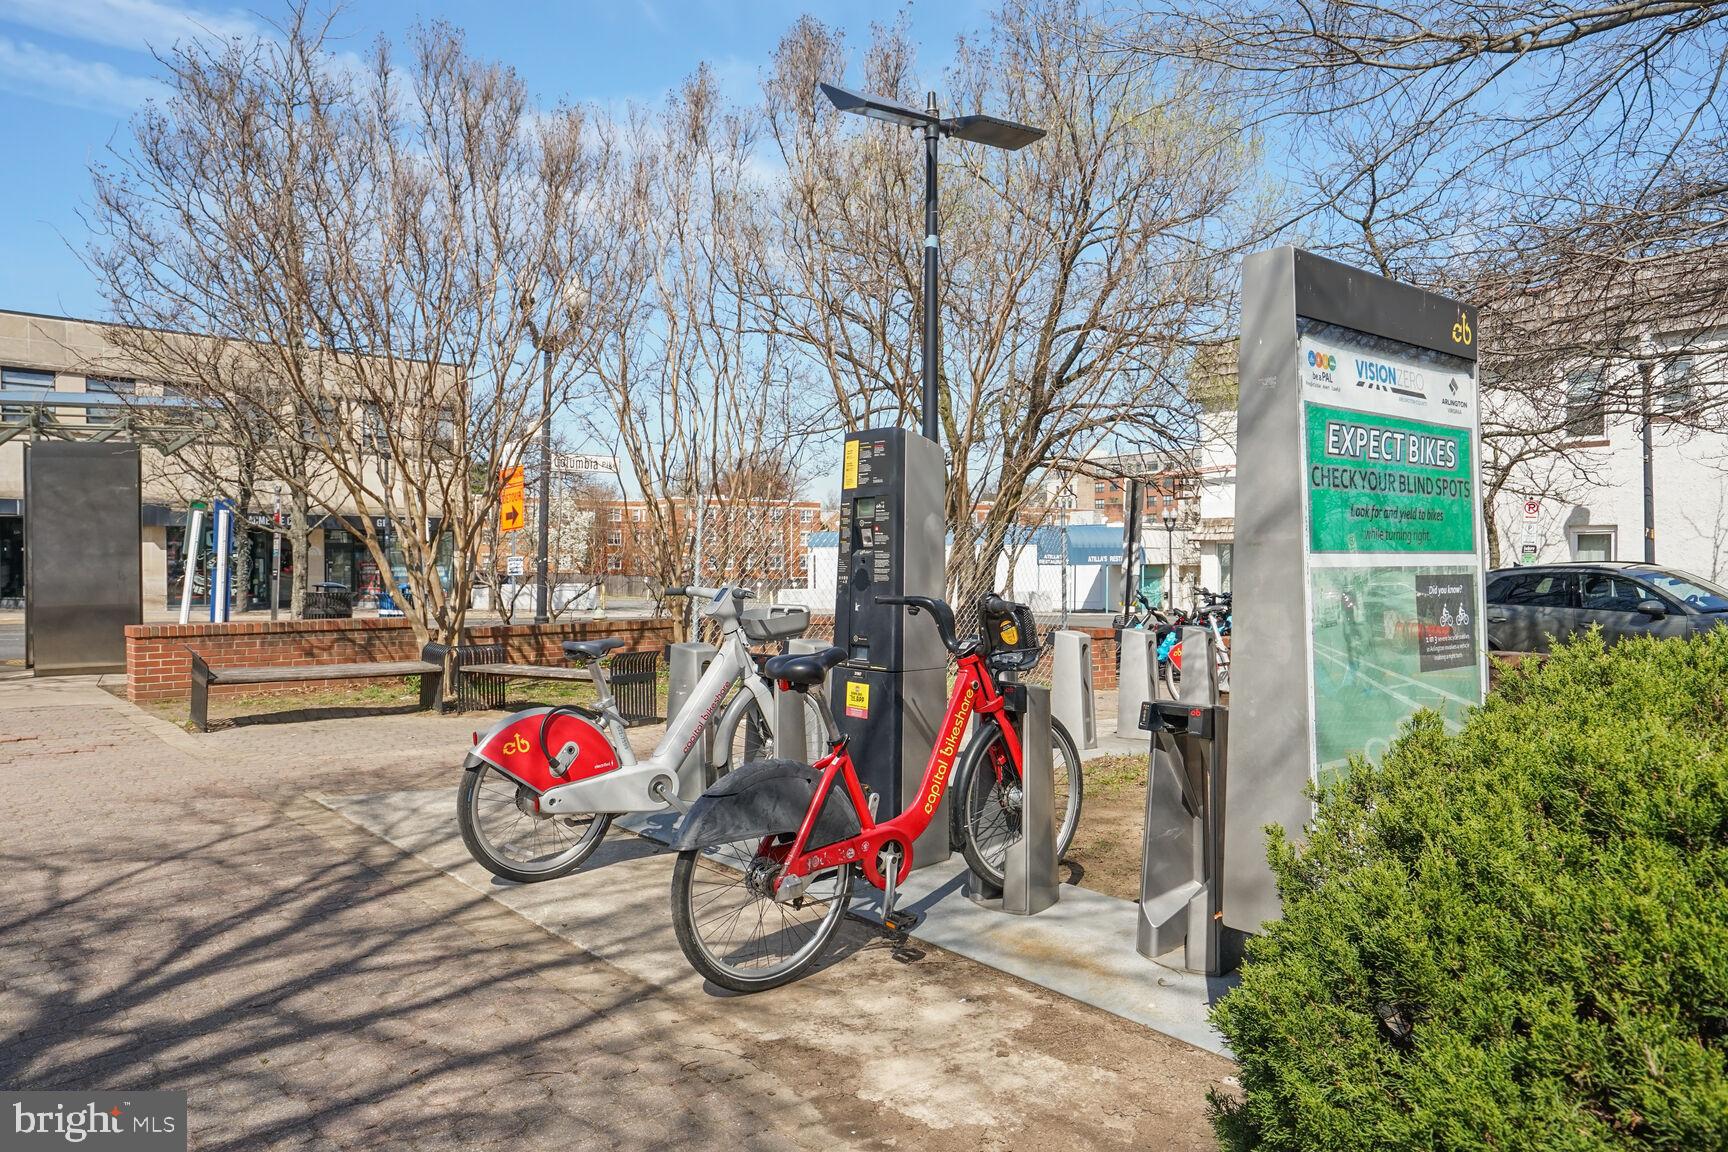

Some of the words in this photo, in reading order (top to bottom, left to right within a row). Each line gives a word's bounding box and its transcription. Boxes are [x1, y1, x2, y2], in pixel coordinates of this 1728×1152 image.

[1322, 371, 1333, 383] PAL
[1441, 398, 1467, 408] ARLINGTON
[1327, 423, 1405, 461] EXPECT
[1408, 434, 1456, 468] BIKES
[1311, 466, 1358, 490] CHECK
[1356, 470, 1396, 493] YOUR
[1399, 474, 1434, 495] BLIND
[1436, 477, 1471, 498] SPOTS
[1350, 504, 1370, 518] Look
[1383, 506, 1398, 519] and
[1399, 508, 1417, 523] yield
[1418, 508, 1425, 519] to
[1426, 508, 1444, 521] bikes
[1385, 530, 1411, 544] turning
[1428, 585, 1438, 595] Did
[1438, 587, 1447, 597] you
[1447, 585, 1463, 594] know?
[682, 721, 703, 754] capital
[701, 681, 731, 722] bikeshare
[923, 760, 950, 814] capital
[946, 688, 973, 757] bikeshare
